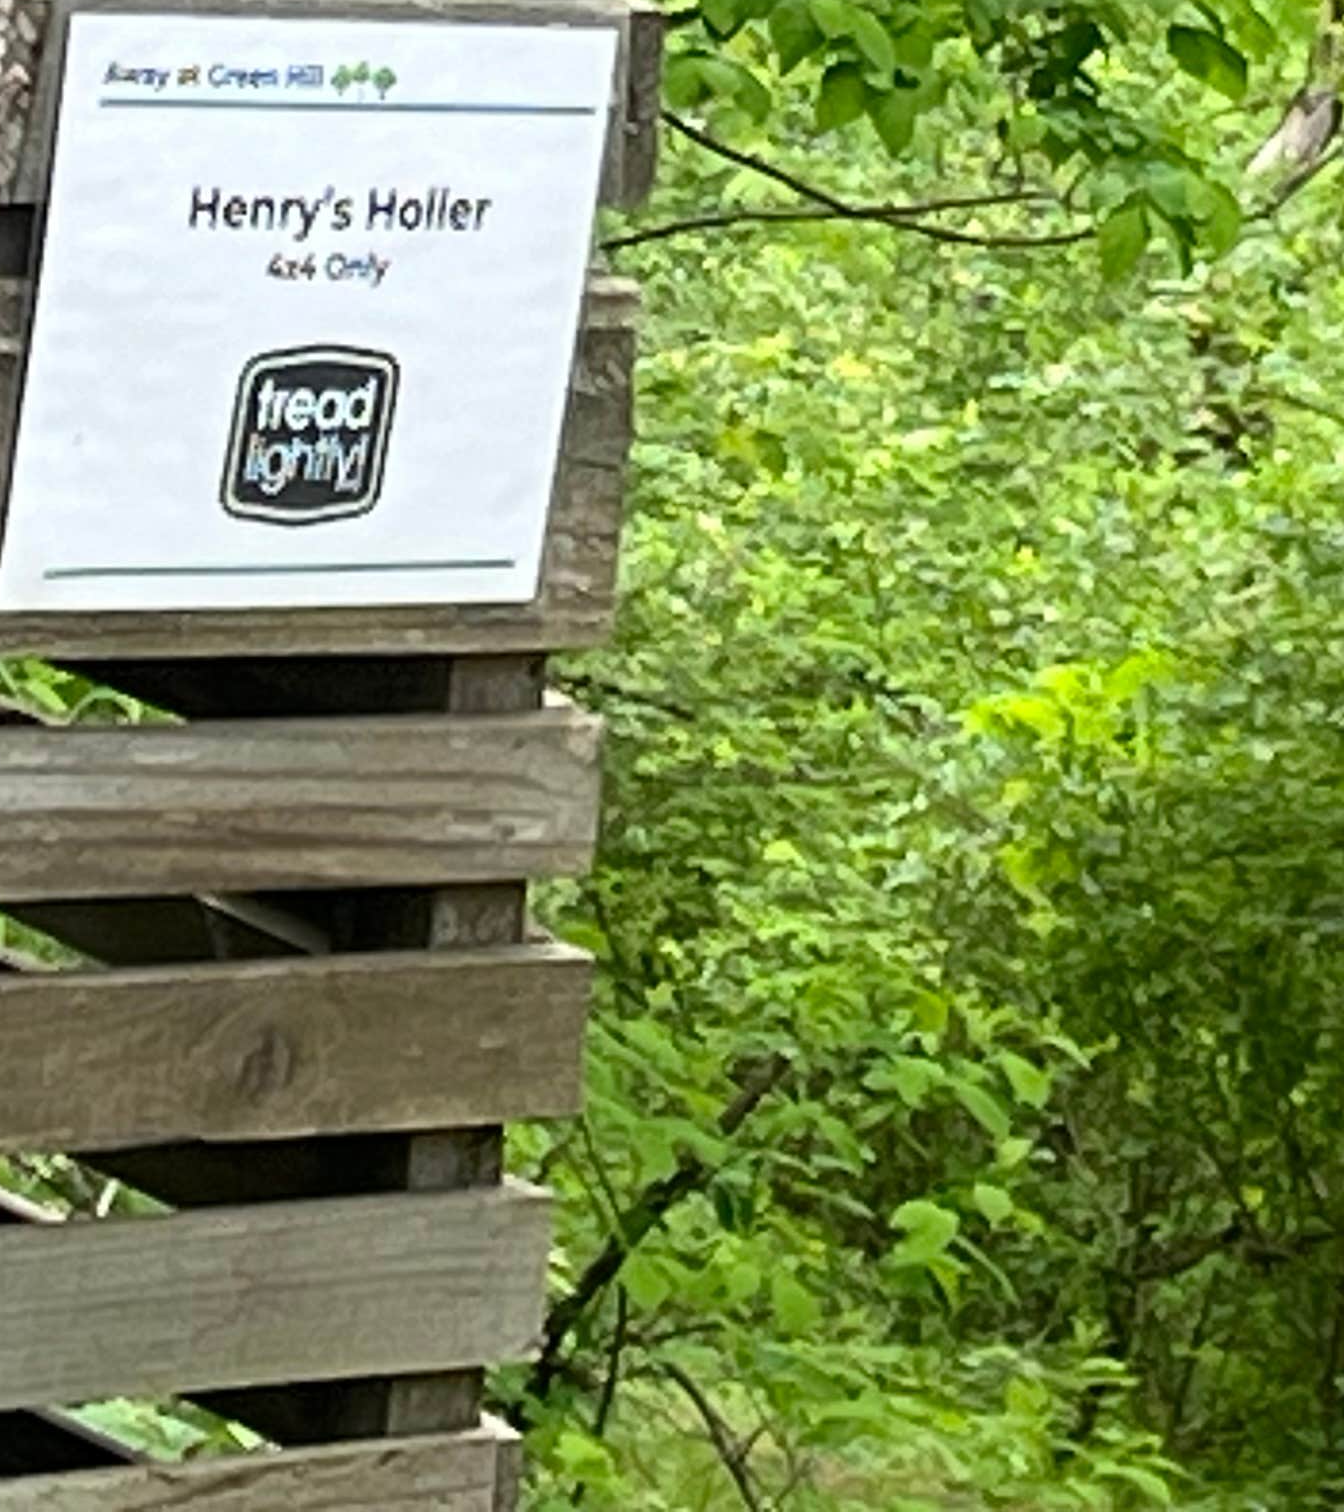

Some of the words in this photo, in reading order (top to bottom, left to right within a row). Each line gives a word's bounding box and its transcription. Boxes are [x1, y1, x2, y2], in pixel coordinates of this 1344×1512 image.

[207, 64, 278, 88] Green
[284, 63, 324, 88] Hill
[188, 185, 354, 242] Henry's
[366, 186, 493, 232] Holler
[266, 251, 316, 282] 4x4
[325, 249, 391, 288] Only
[257, 376, 378, 431] tread
